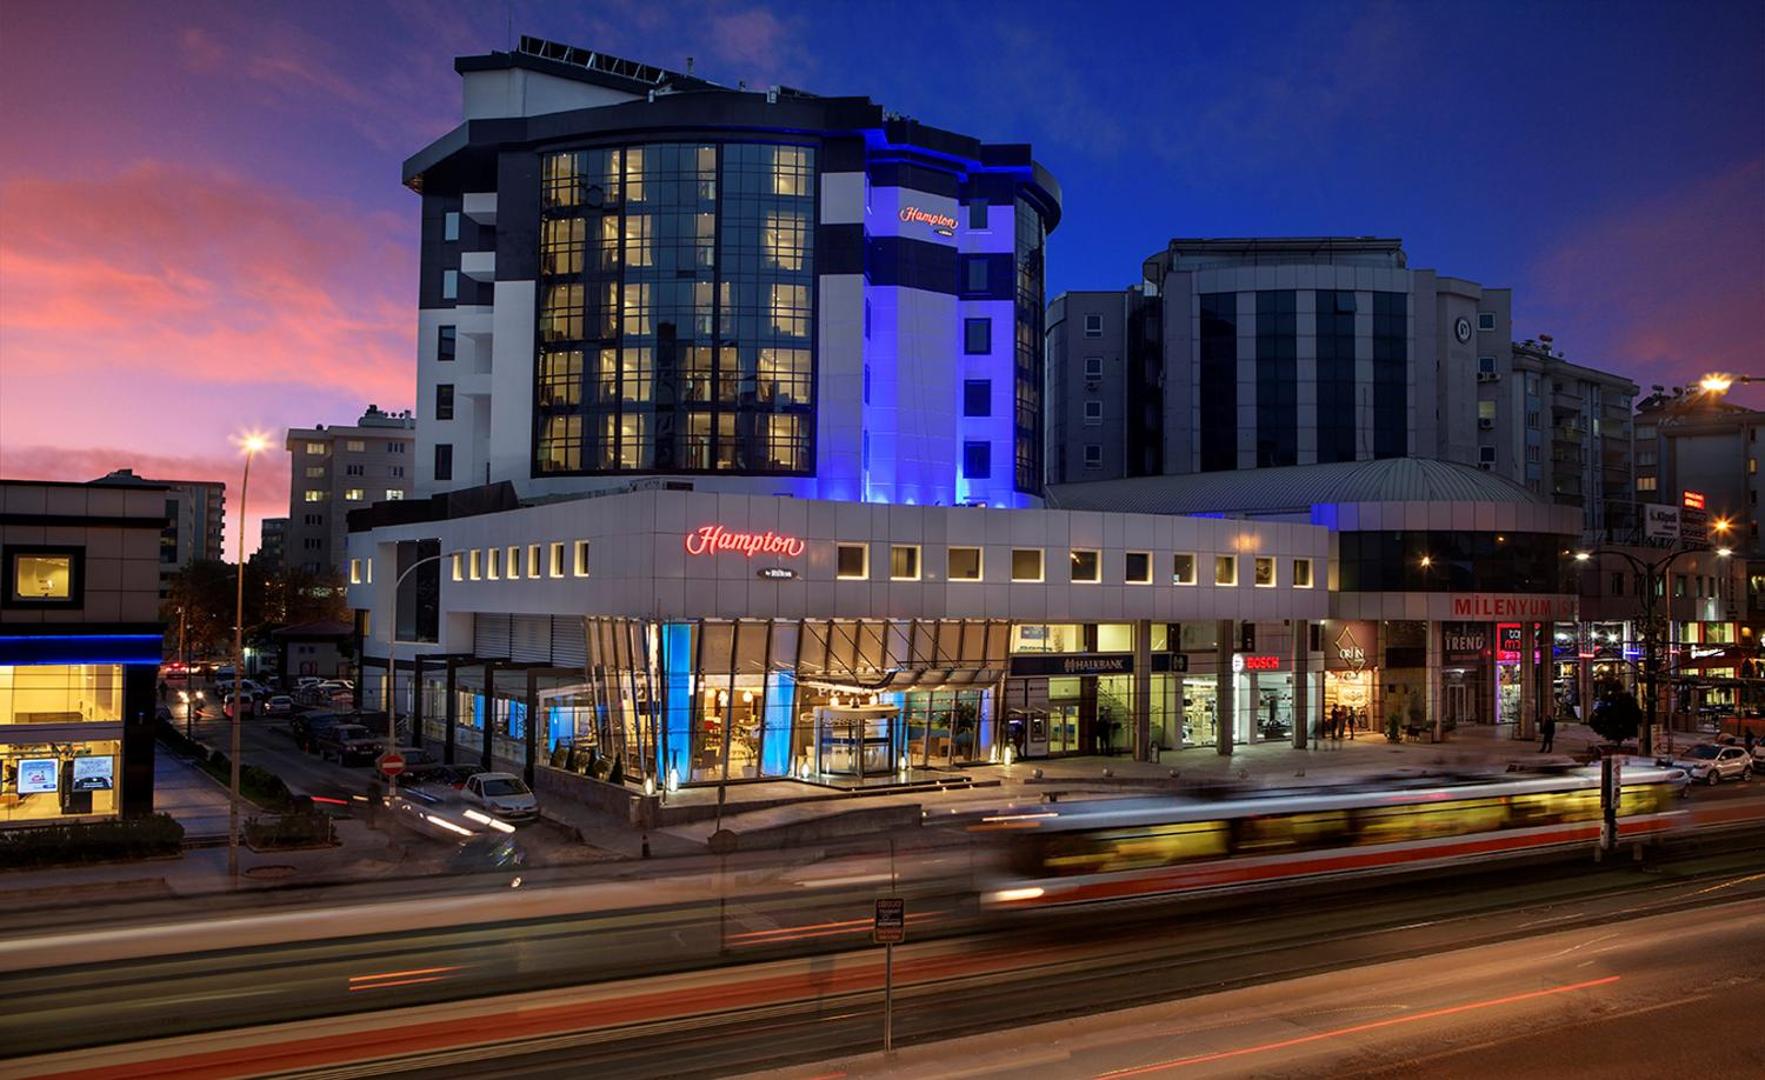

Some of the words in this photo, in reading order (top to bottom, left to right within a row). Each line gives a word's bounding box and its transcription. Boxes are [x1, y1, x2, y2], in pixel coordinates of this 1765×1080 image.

[899, 206, 959, 229] Hampton
[686, 525, 805, 556] Hampton
[1445, 635, 1483, 651] TREND
[1075, 659, 1124, 671] HALKBANK
[1247, 656, 1280, 669] BOSCH
